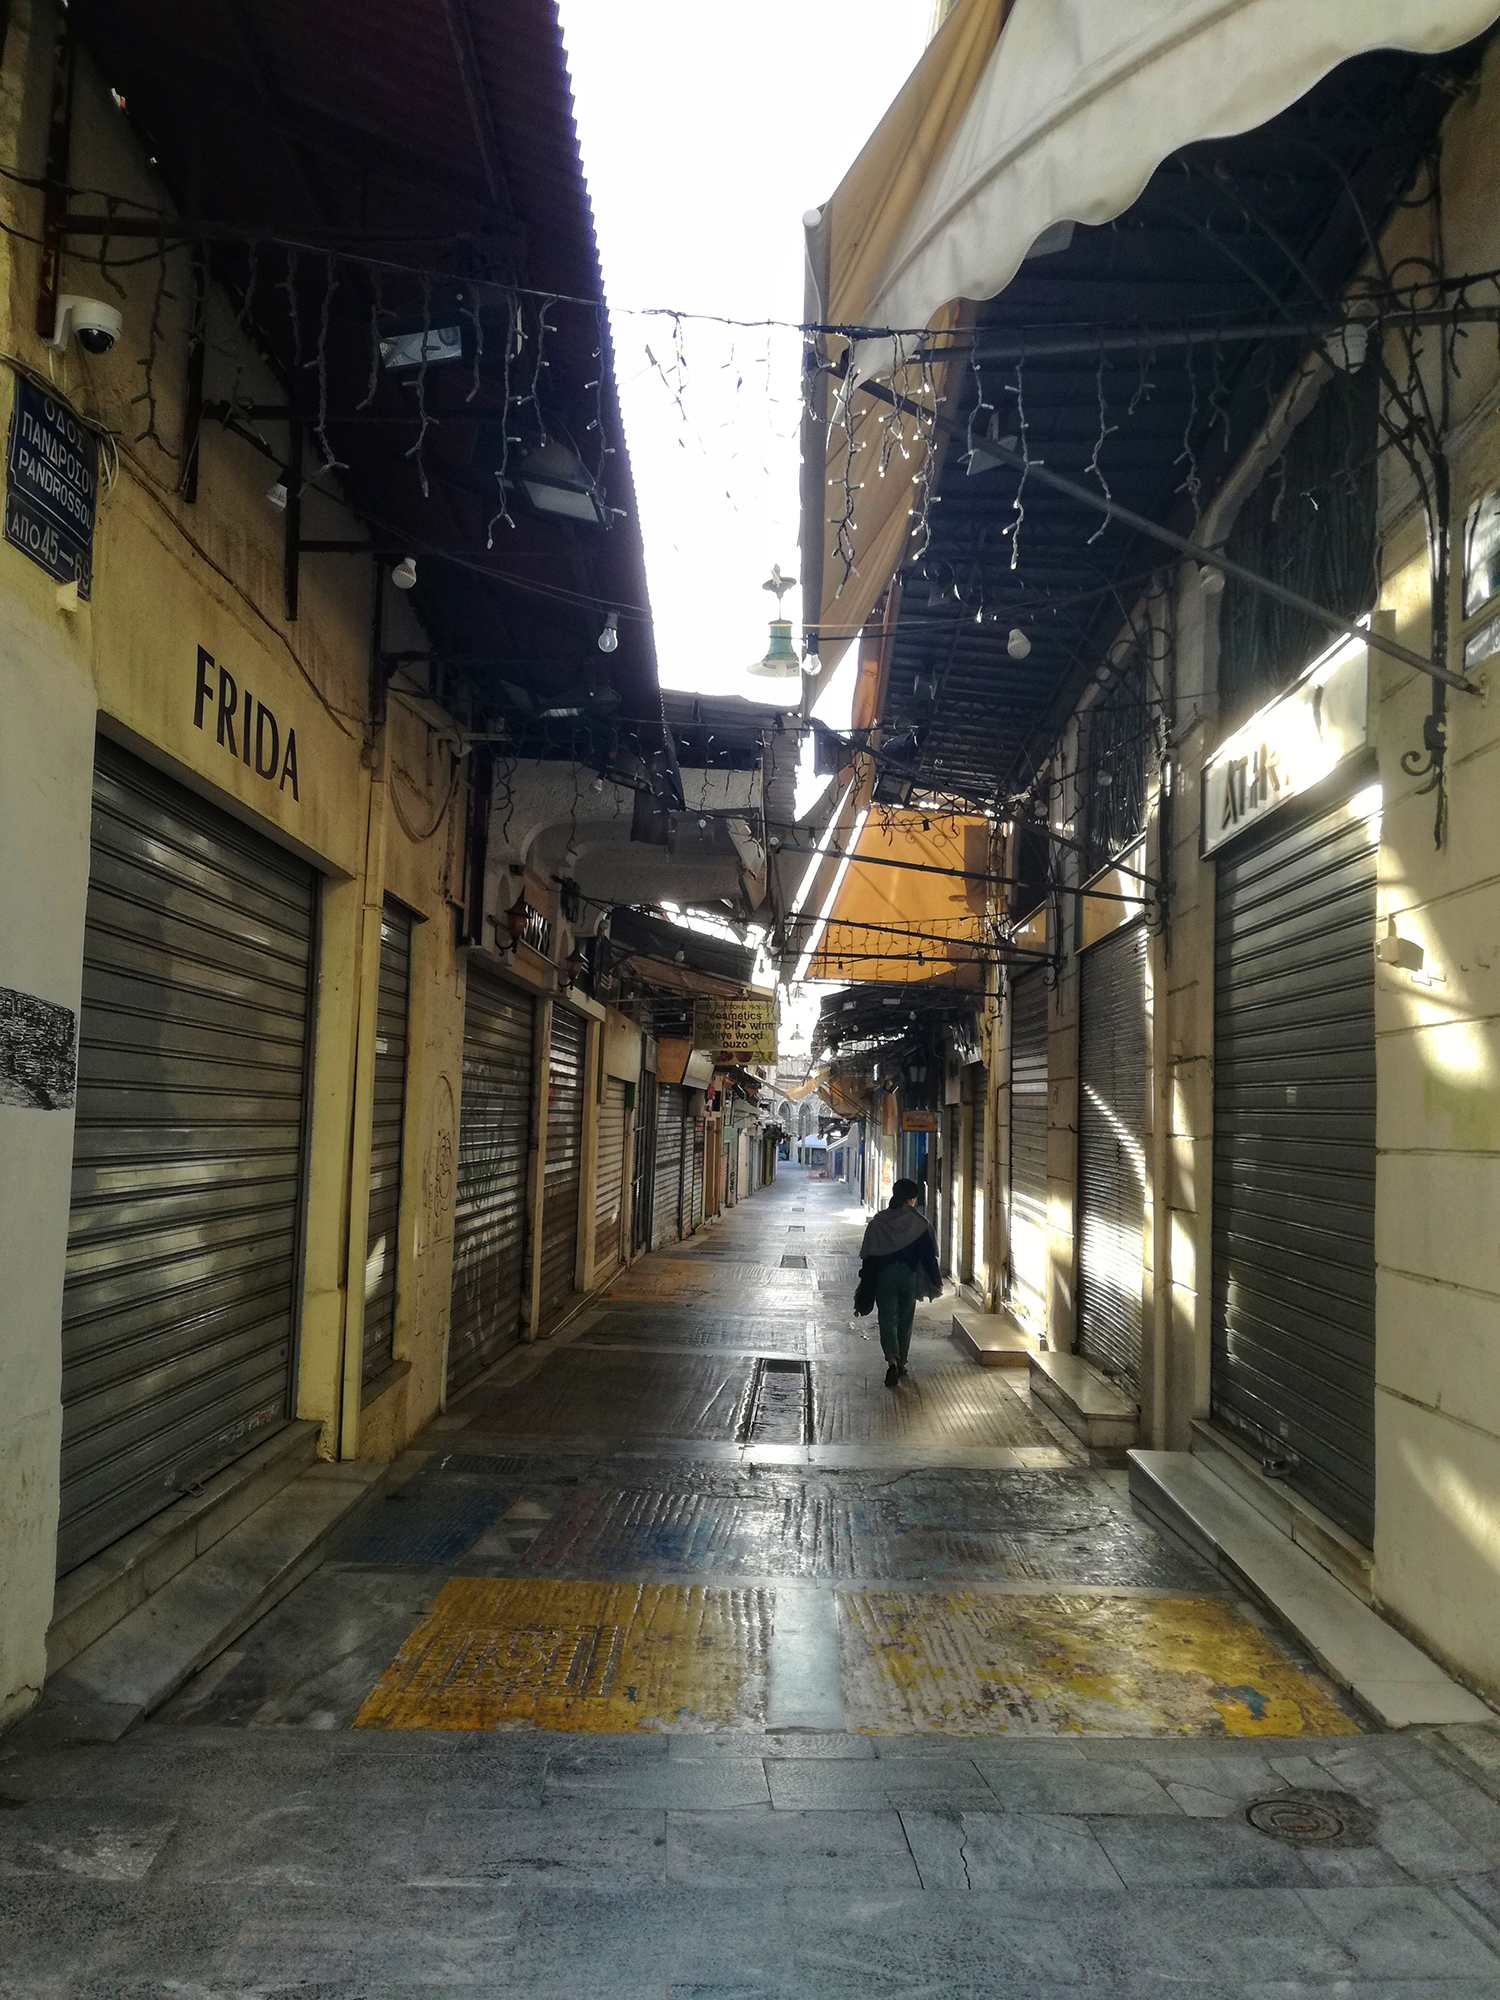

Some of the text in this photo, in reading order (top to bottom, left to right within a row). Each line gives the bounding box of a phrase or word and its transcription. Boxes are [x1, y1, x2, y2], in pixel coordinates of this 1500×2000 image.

[44, 397, 84, 453] ΟΔΟΣ
[22, 410, 95, 500] ΠΑΝΔΡΟΣΟΥ
[19, 447, 92, 530] PANDROSSOU
[11, 511, 91, 591] ΑΠΟ 45 69
[193, 643, 299, 803] FRIDA
[697, 1021, 722, 1030] olive
[749, 1021, 774, 1030] wine
[708, 1031, 763, 1040] olive wood
[710, 1011, 762, 1020] cosmetics
[722, 1040, 748, 1049] ouzo
